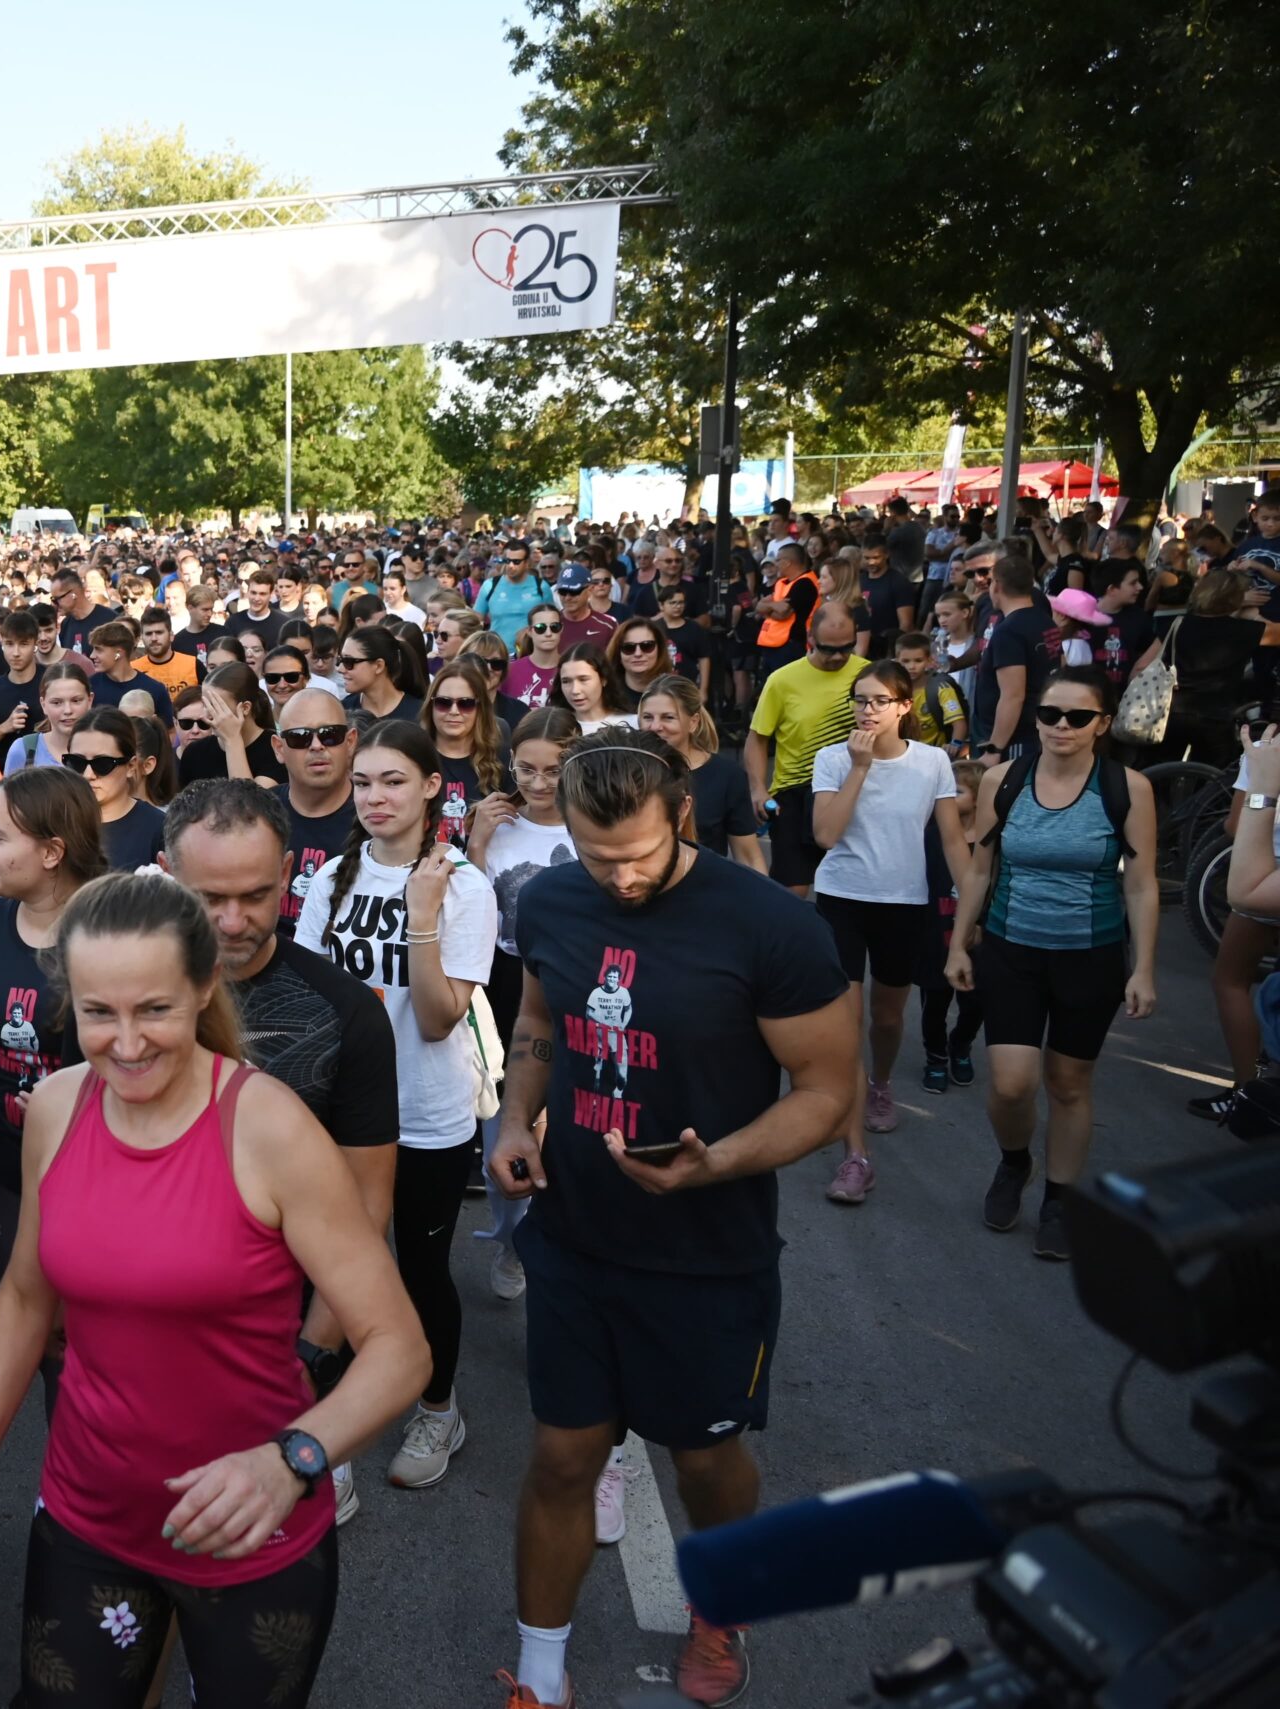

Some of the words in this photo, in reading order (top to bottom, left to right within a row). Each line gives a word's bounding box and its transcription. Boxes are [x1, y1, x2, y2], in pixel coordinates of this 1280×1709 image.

[513, 223, 598, 304] 25
[512, 293, 541, 307] GODINA
[542, 292, 549, 304] U
[517, 304, 562, 320] HRVATSKOJ
[300, 847, 326, 873] NO
[381, 942, 410, 988] IT
[598, 945, 637, 989] NO
[4, 986, 38, 1023] NO
[564, 1013, 658, 1070] MATTER
[574, 1087, 641, 1140] WHAT
